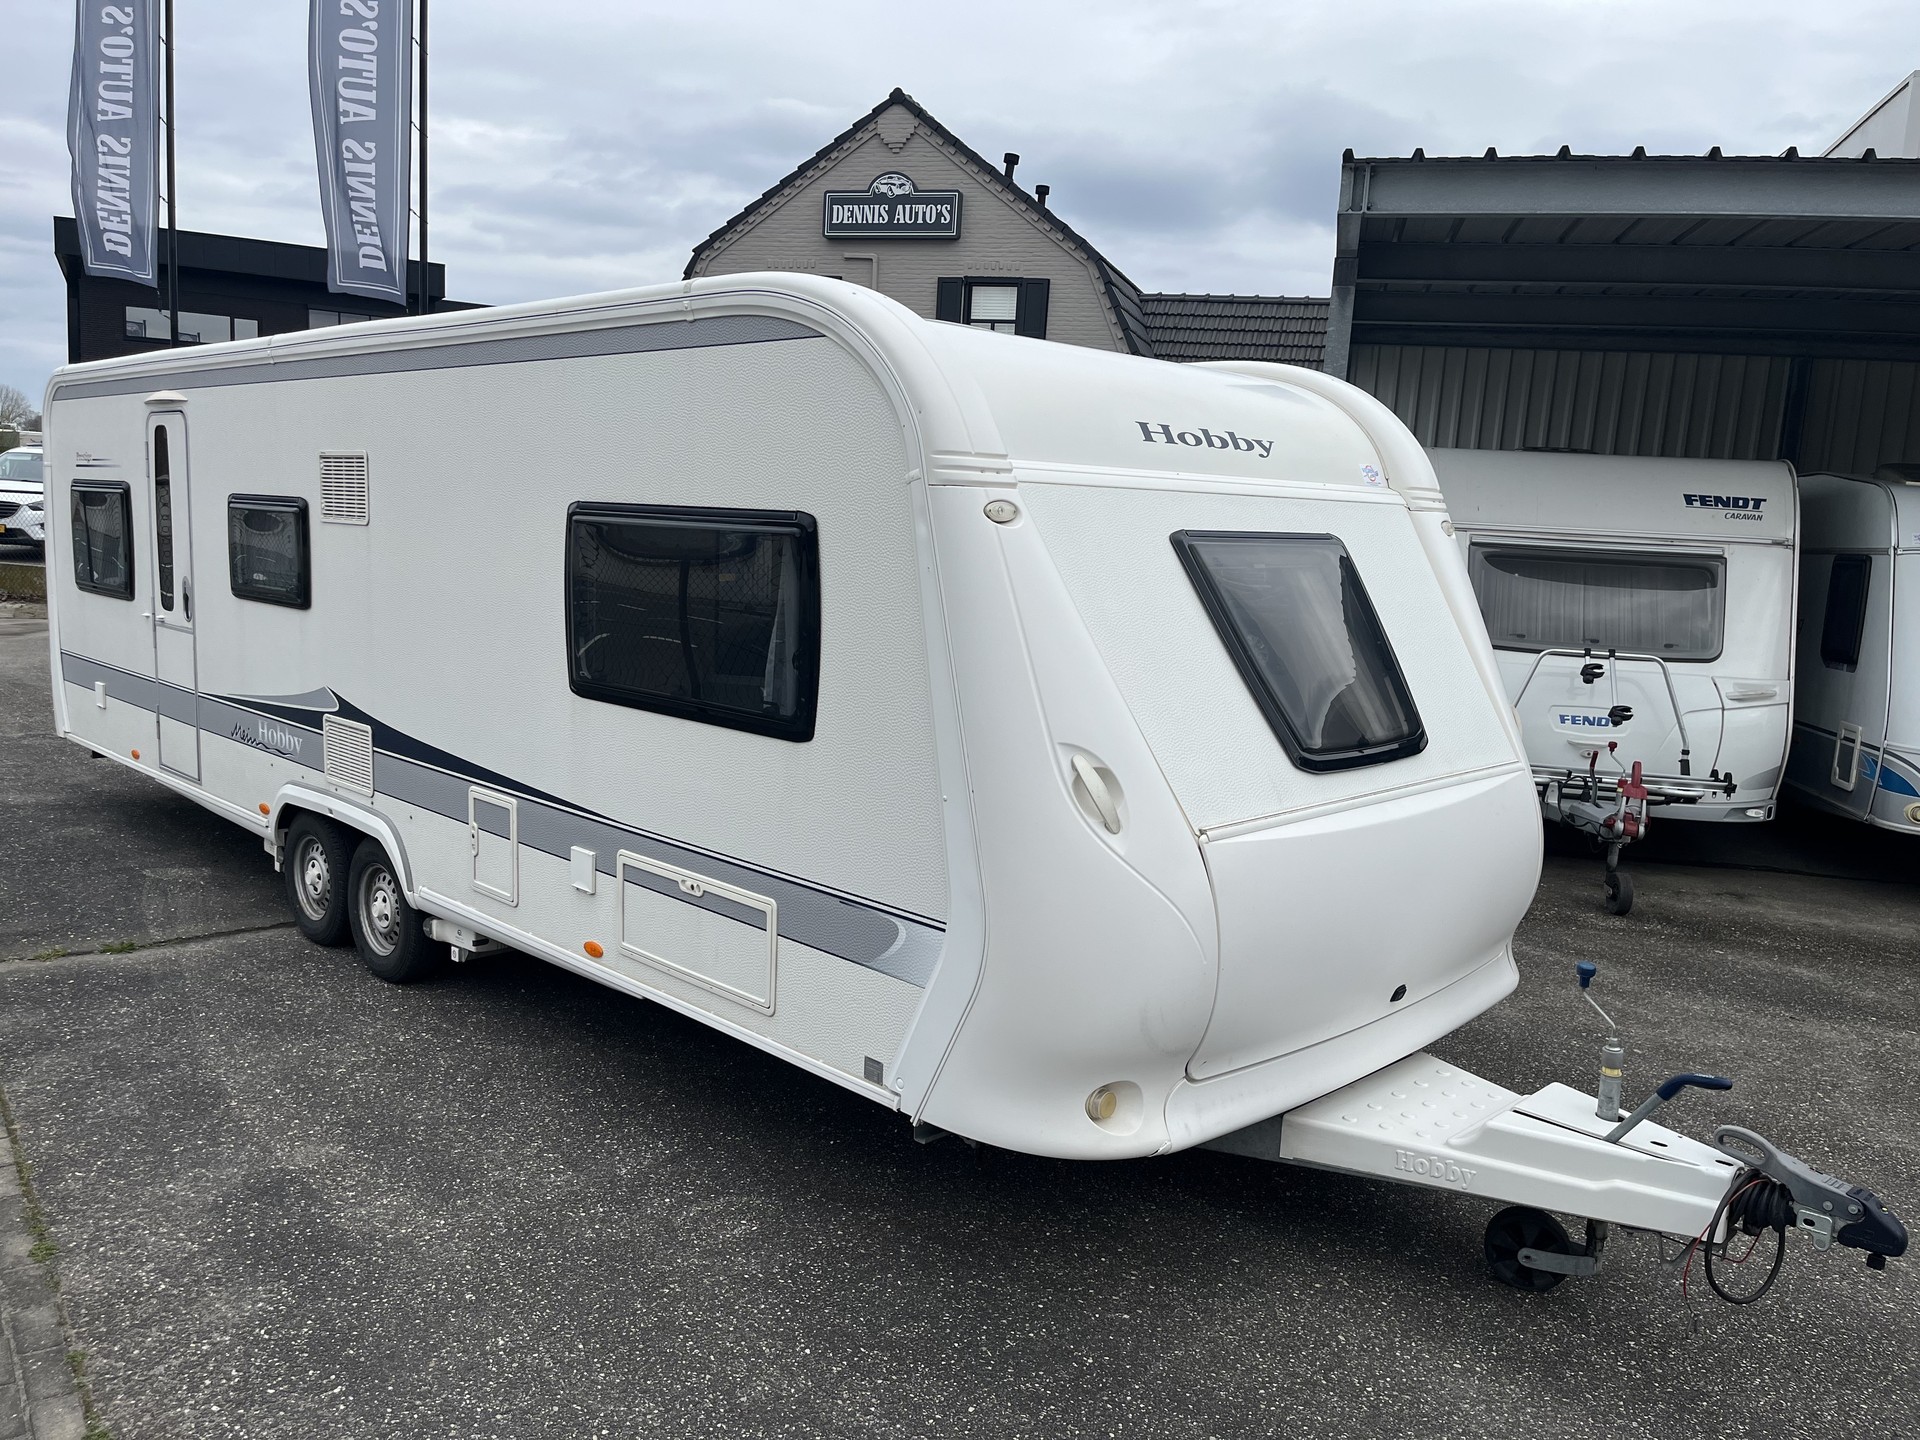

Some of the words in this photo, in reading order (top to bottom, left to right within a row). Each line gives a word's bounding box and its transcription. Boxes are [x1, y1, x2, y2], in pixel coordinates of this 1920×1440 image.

[832, 204, 889, 224] DENNIS
[893, 204, 951, 224] AUTO'S
[1135, 421, 1275, 459] Hobby
[1683, 493, 1767, 510] FENDT
[1724, 512, 1764, 521] CARAVAN
[1558, 714, 1612, 727] FEND
[258, 720, 303, 757] Hobby
[1394, 1149, 1477, 1190] Hobby
